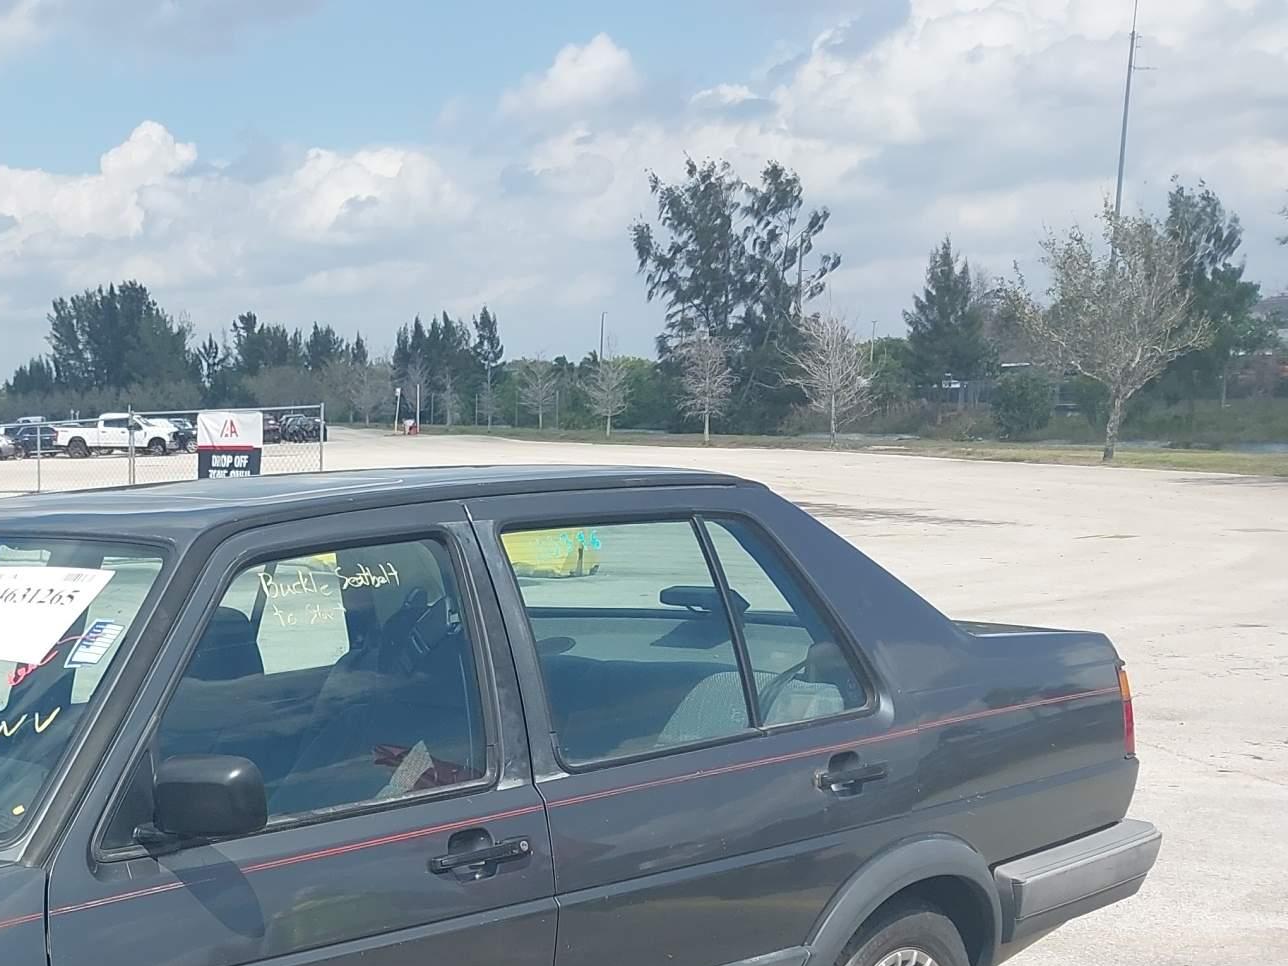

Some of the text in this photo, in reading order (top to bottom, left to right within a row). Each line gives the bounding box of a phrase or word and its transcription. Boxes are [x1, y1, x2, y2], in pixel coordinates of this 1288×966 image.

[212, 455, 249, 468] DROP OFF
[258, 562, 400, 599] Buckle Seatbelt
[273, 604, 297, 627] to
